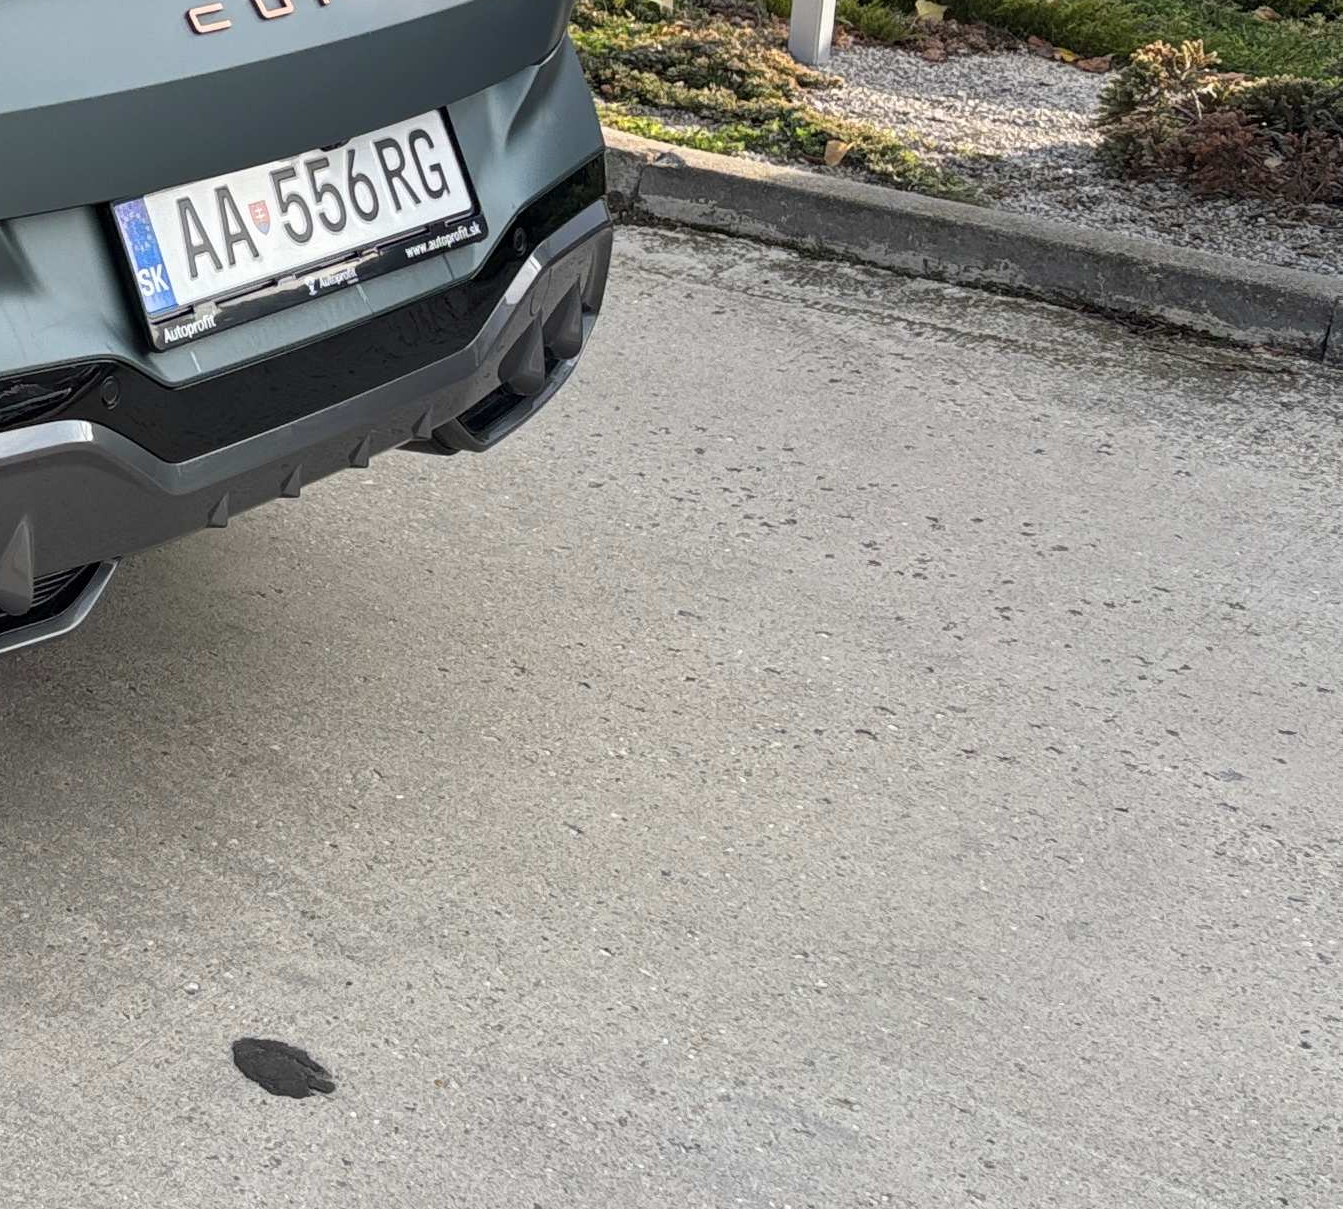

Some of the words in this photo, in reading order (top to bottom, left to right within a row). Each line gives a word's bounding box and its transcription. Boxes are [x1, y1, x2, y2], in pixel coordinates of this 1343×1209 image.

[176, 184, 260, 281] AA
[404, 221, 483, 259] www.autoprofit.sk
[138, 264, 170, 297] SK
[163, 312, 217, 344] Autoprofit
